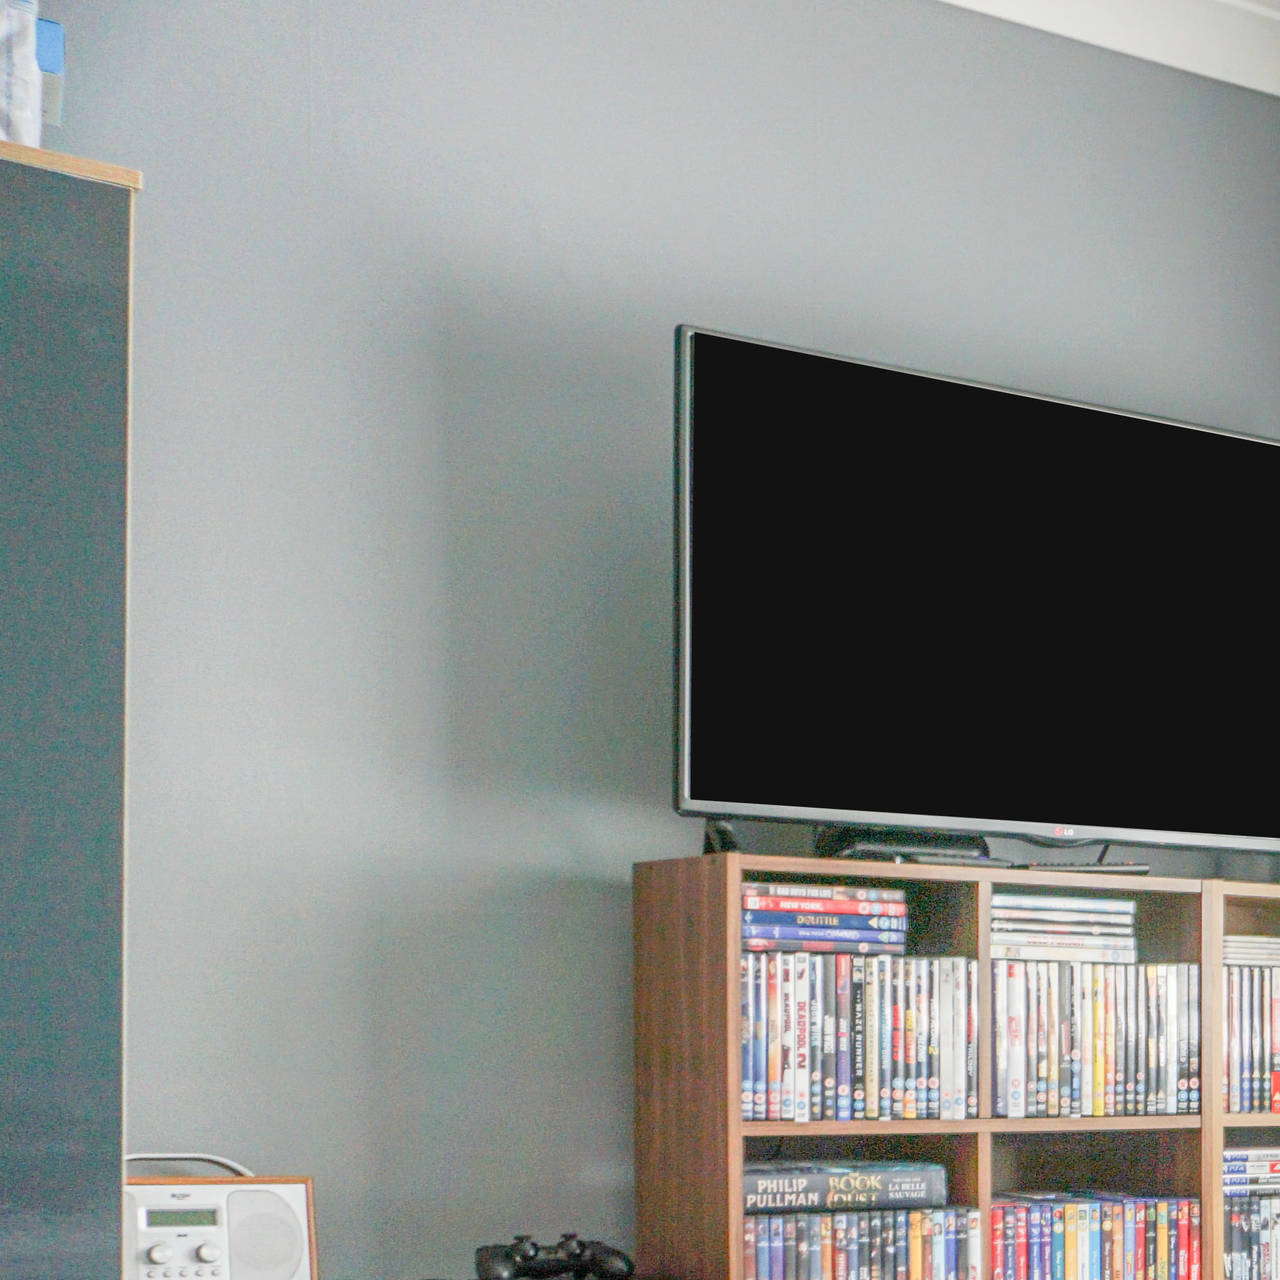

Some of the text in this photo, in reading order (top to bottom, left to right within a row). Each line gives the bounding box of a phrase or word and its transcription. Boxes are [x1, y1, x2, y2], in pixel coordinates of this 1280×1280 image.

[797, 1001, 806, 1069] DEADPOOL 2
[757, 1178, 807, 1193] PHILIP
[746, 1192, 819, 1207] PULLMAN
[889, 1191, 926, 1199] SAUVAGE
